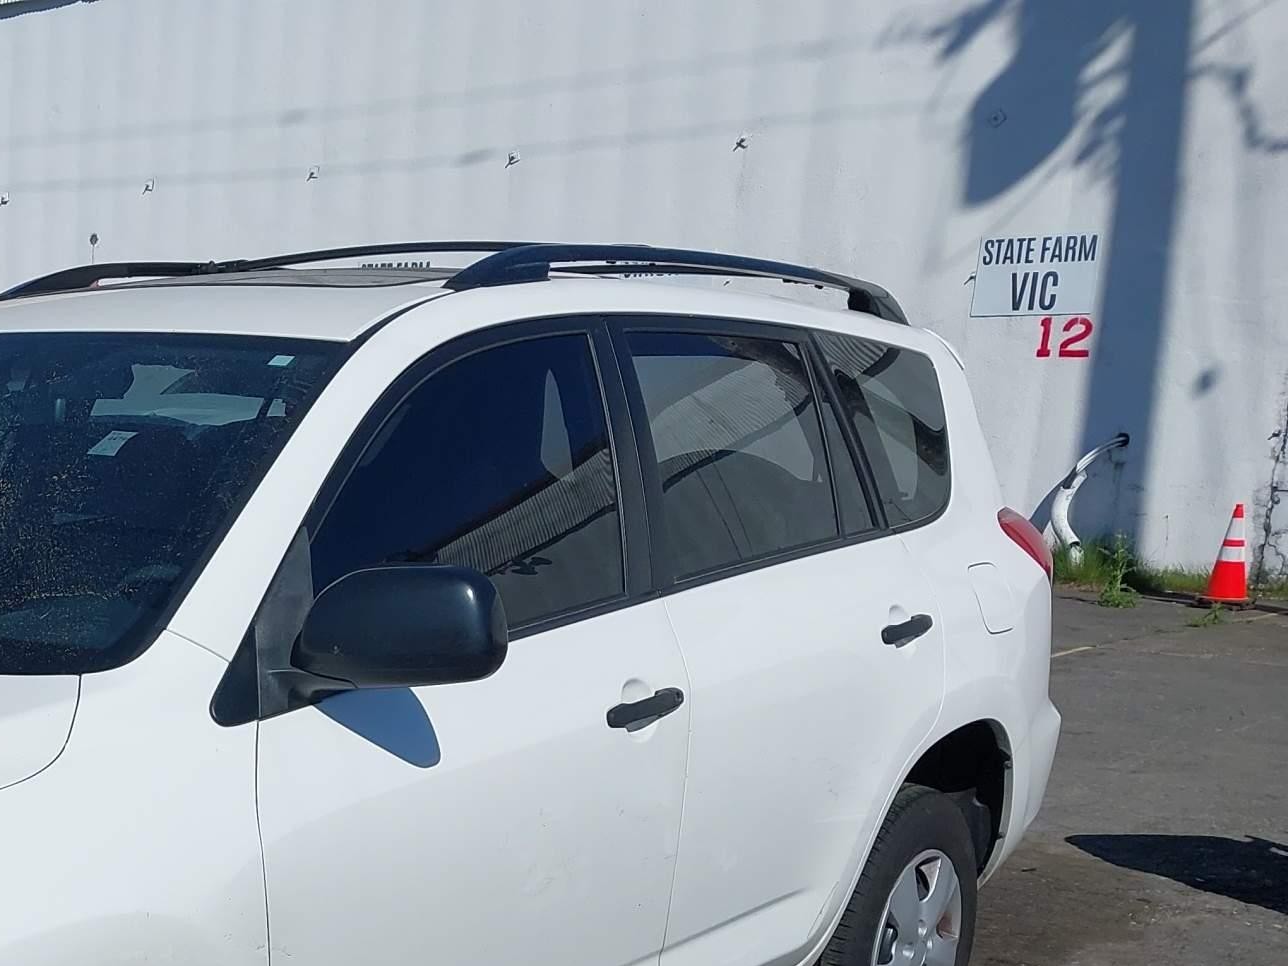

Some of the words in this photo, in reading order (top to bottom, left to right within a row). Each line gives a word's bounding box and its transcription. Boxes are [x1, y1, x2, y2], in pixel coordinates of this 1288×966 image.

[982, 237, 1037, 266] STATE
[1040, 235, 1098, 263] FARM
[1011, 271, 1059, 311] VIC
[1036, 316, 1094, 358] 12
